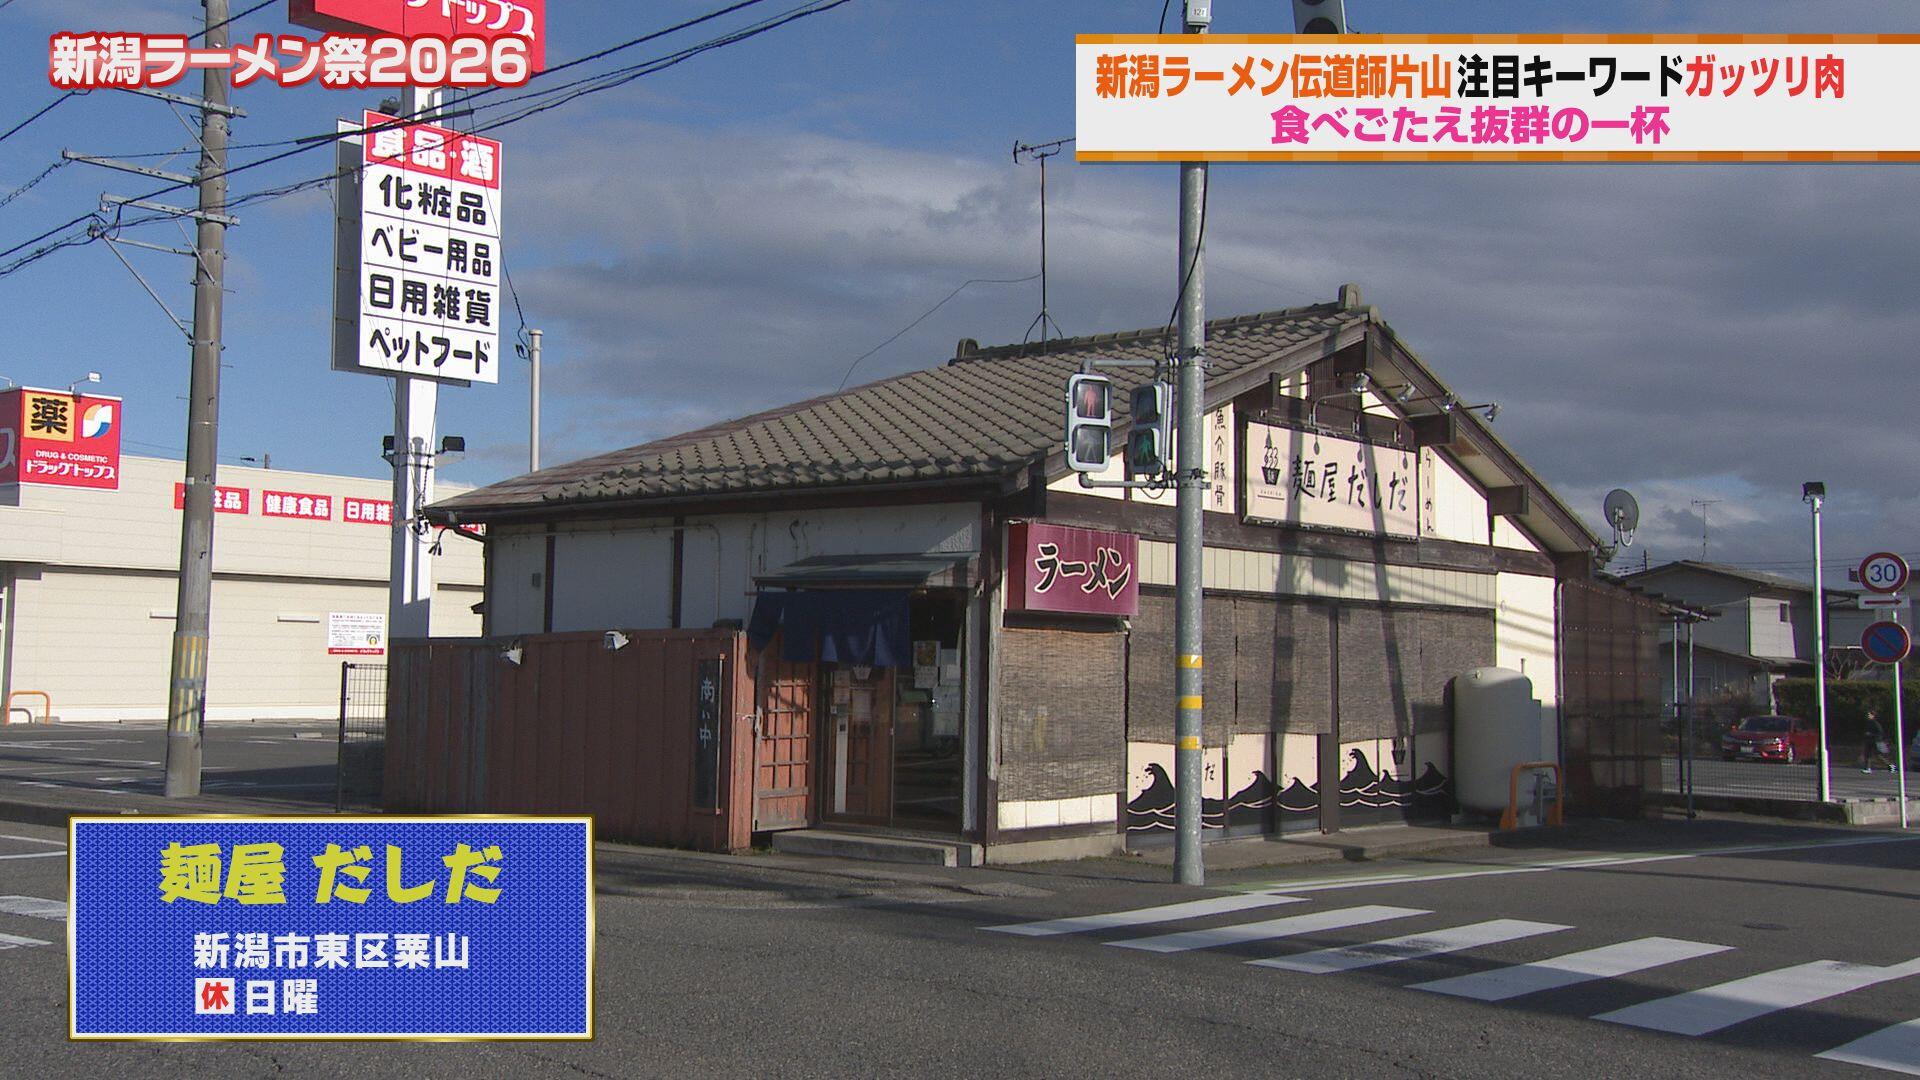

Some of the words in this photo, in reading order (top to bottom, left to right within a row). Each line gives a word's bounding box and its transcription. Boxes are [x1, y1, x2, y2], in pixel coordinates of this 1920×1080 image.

[379, 174, 486, 226] 化粧品
[372, 225, 491, 277] ベビー用品
[370, 274, 491, 326] 日用雑貨
[369, 327, 491, 374] ペットフード
[31, 397, 68, 434] 薬
[26, 459, 115, 479] ドラッグトップス
[36, 450, 59, 460] DRUG
[68, 453, 108, 463] COSMETIC
[1214, 407, 1227, 507] 魚介豚骨
[265, 494, 330, 517] 健康食品
[346, 501, 393, 522] 日用雑
[1033, 542, 1133, 601] ラーメン
[1870, 563, 1896, 582] 30
[699, 676, 715, 749] 商い中
